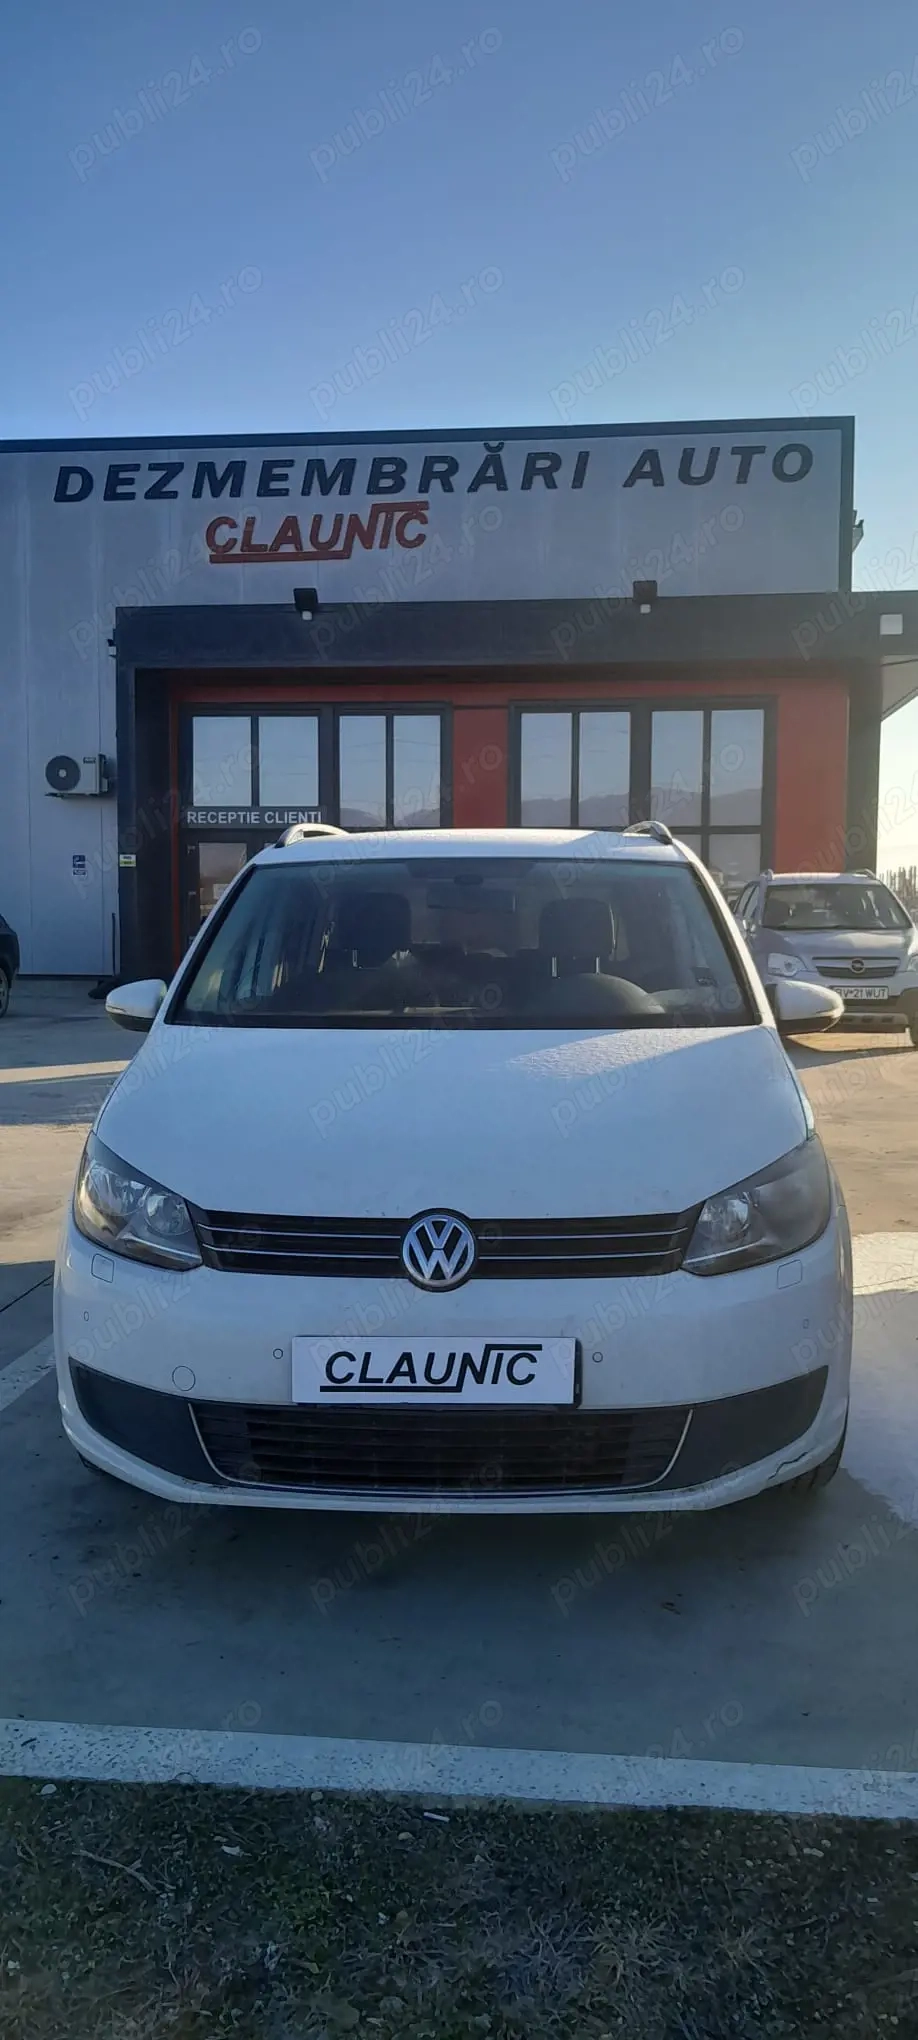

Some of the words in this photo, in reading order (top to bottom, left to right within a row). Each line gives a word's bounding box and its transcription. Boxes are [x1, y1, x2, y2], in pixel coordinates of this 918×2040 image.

[53, 441, 590, 502] DEZMEMBRĂRI
[622, 443, 814, 488] AUTO
[205, 501, 430, 564] CLAUNIC
[186, 811, 260, 824] RECEPTIE
[264, 811, 322, 824] CLIENTI
[319, 1344, 543, 1393] CLAUNIC
